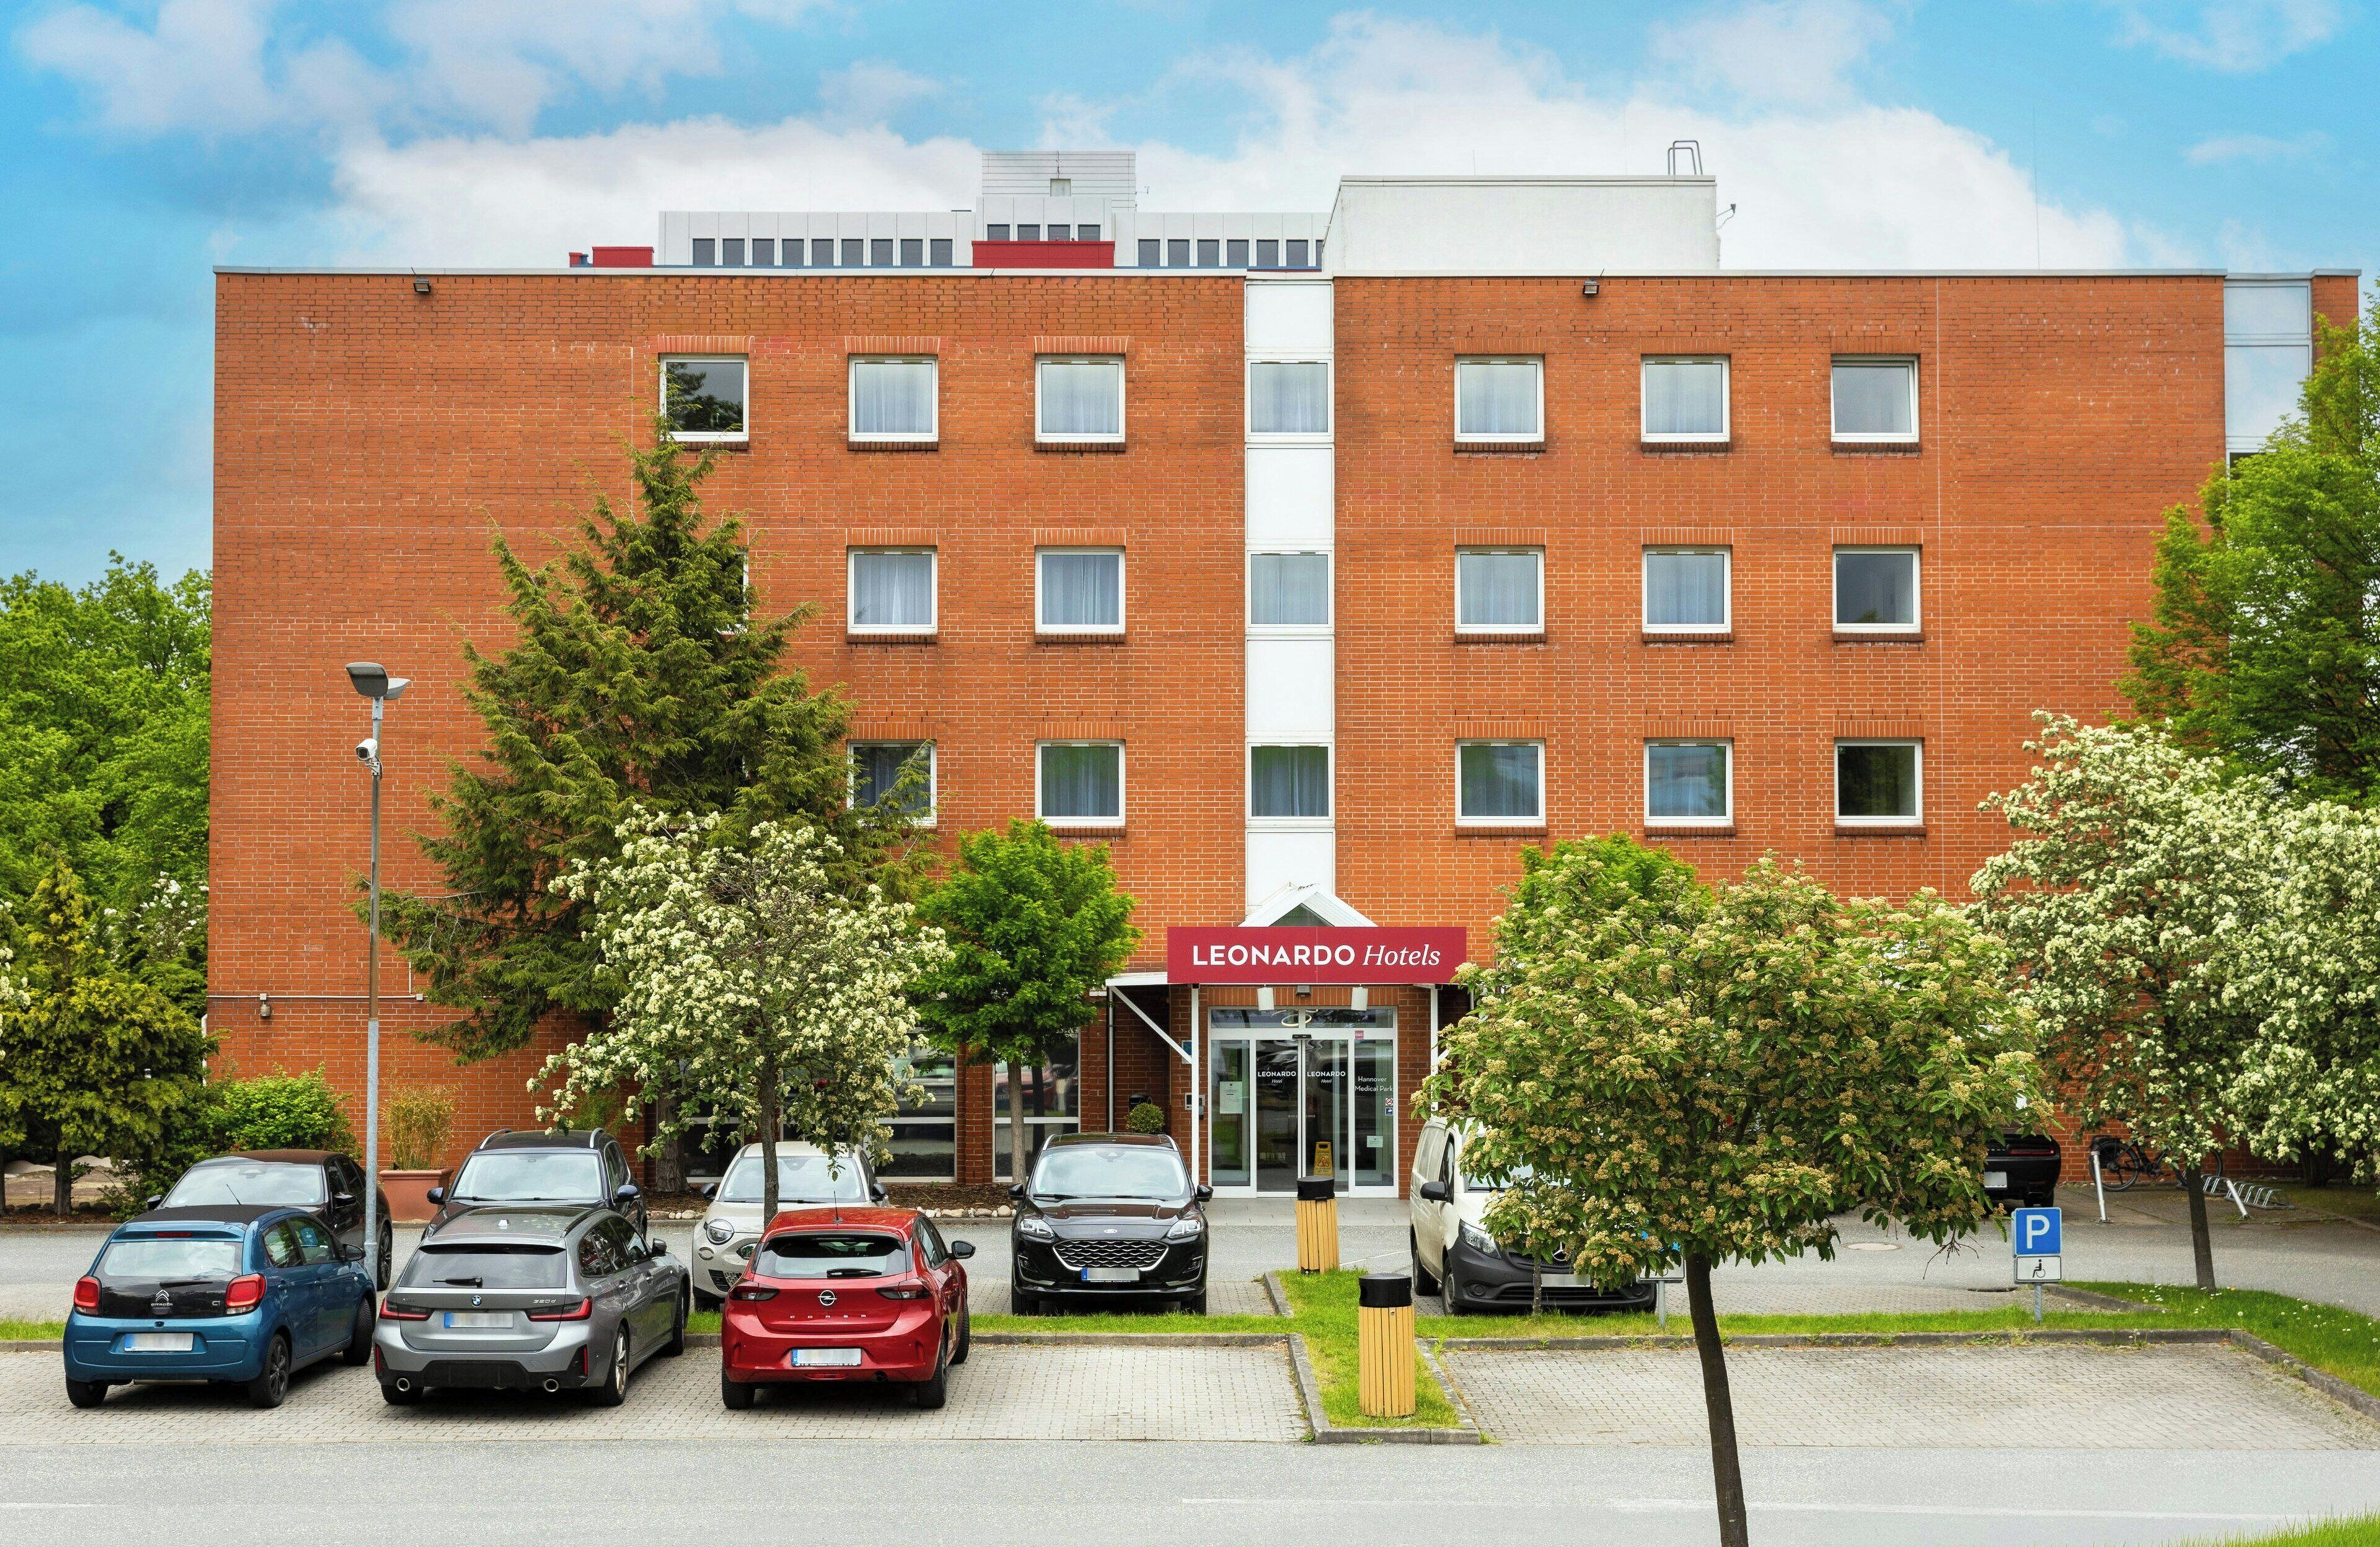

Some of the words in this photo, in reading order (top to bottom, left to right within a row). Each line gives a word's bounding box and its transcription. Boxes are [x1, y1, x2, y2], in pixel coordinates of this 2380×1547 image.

[1193, 945, 1355, 966] LEONARDO
[1362, 944, 1441, 966] Hotels
[2026, 1215, 2050, 1249] P
